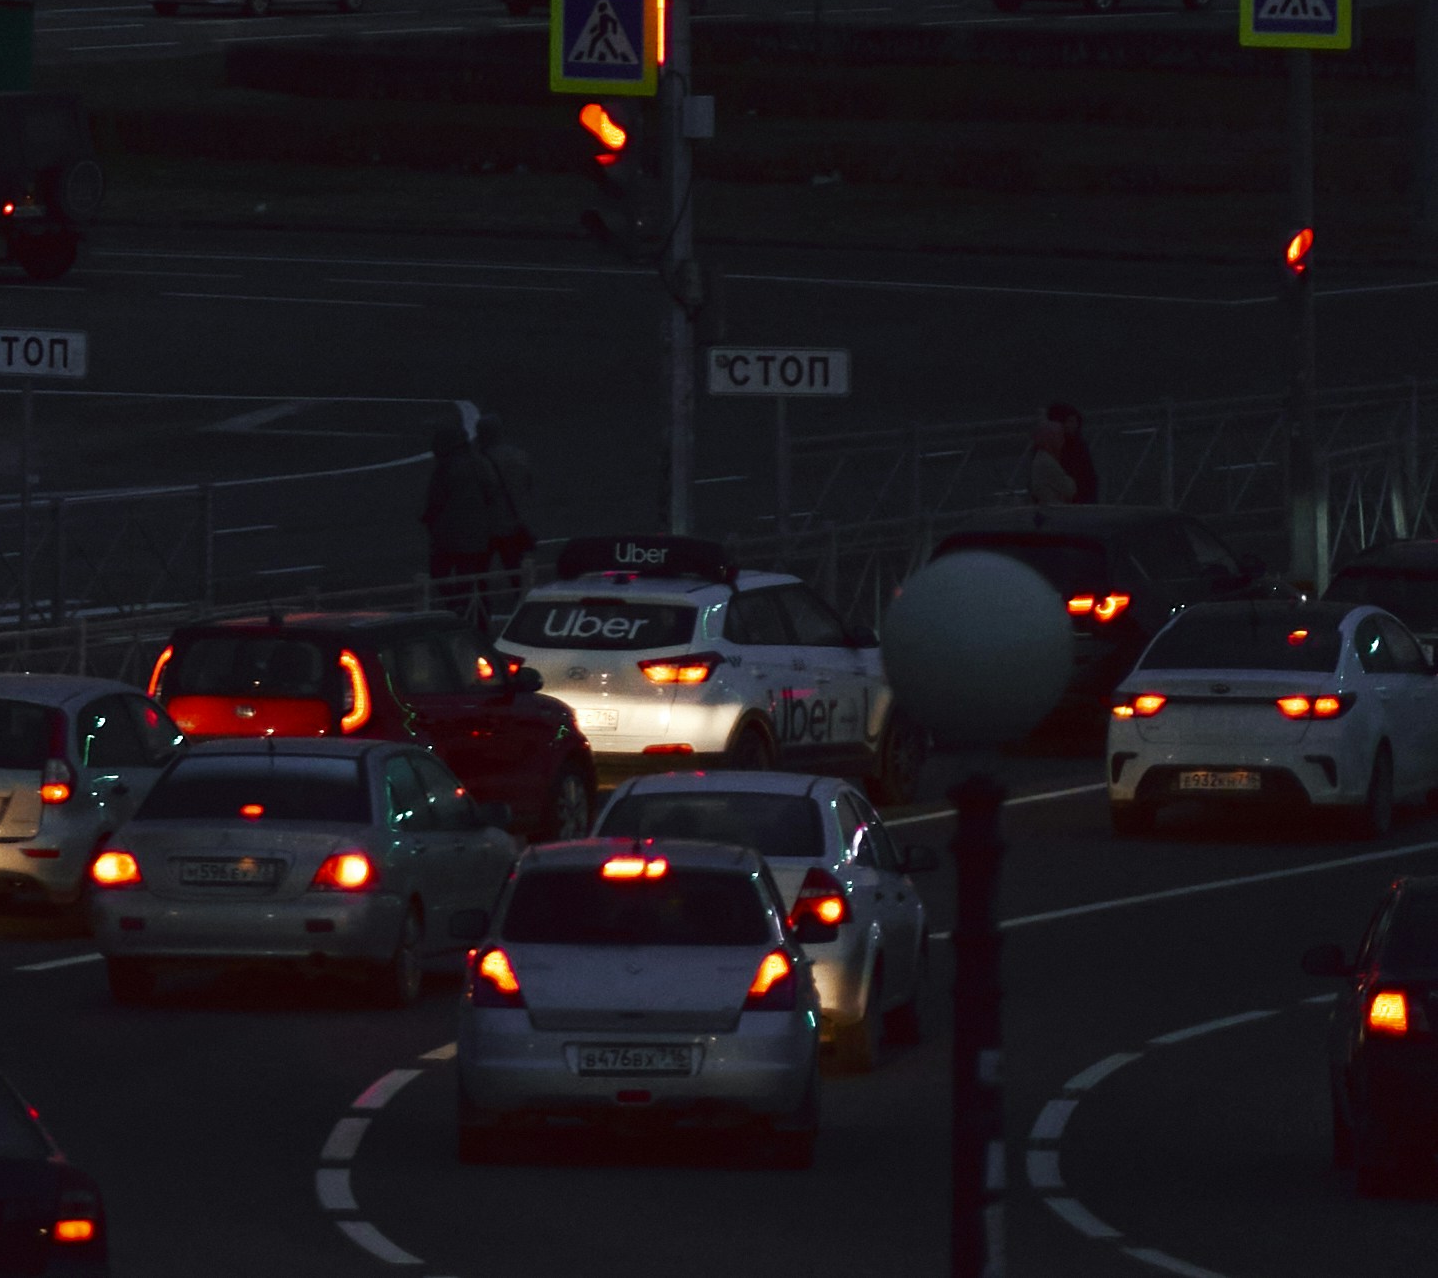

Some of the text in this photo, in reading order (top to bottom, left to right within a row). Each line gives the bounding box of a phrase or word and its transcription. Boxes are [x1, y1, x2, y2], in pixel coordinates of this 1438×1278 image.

[728, 355, 829, 387] СТОП
[615, 542, 669, 563] Uber
[543, 608, 650, 640] Uber
